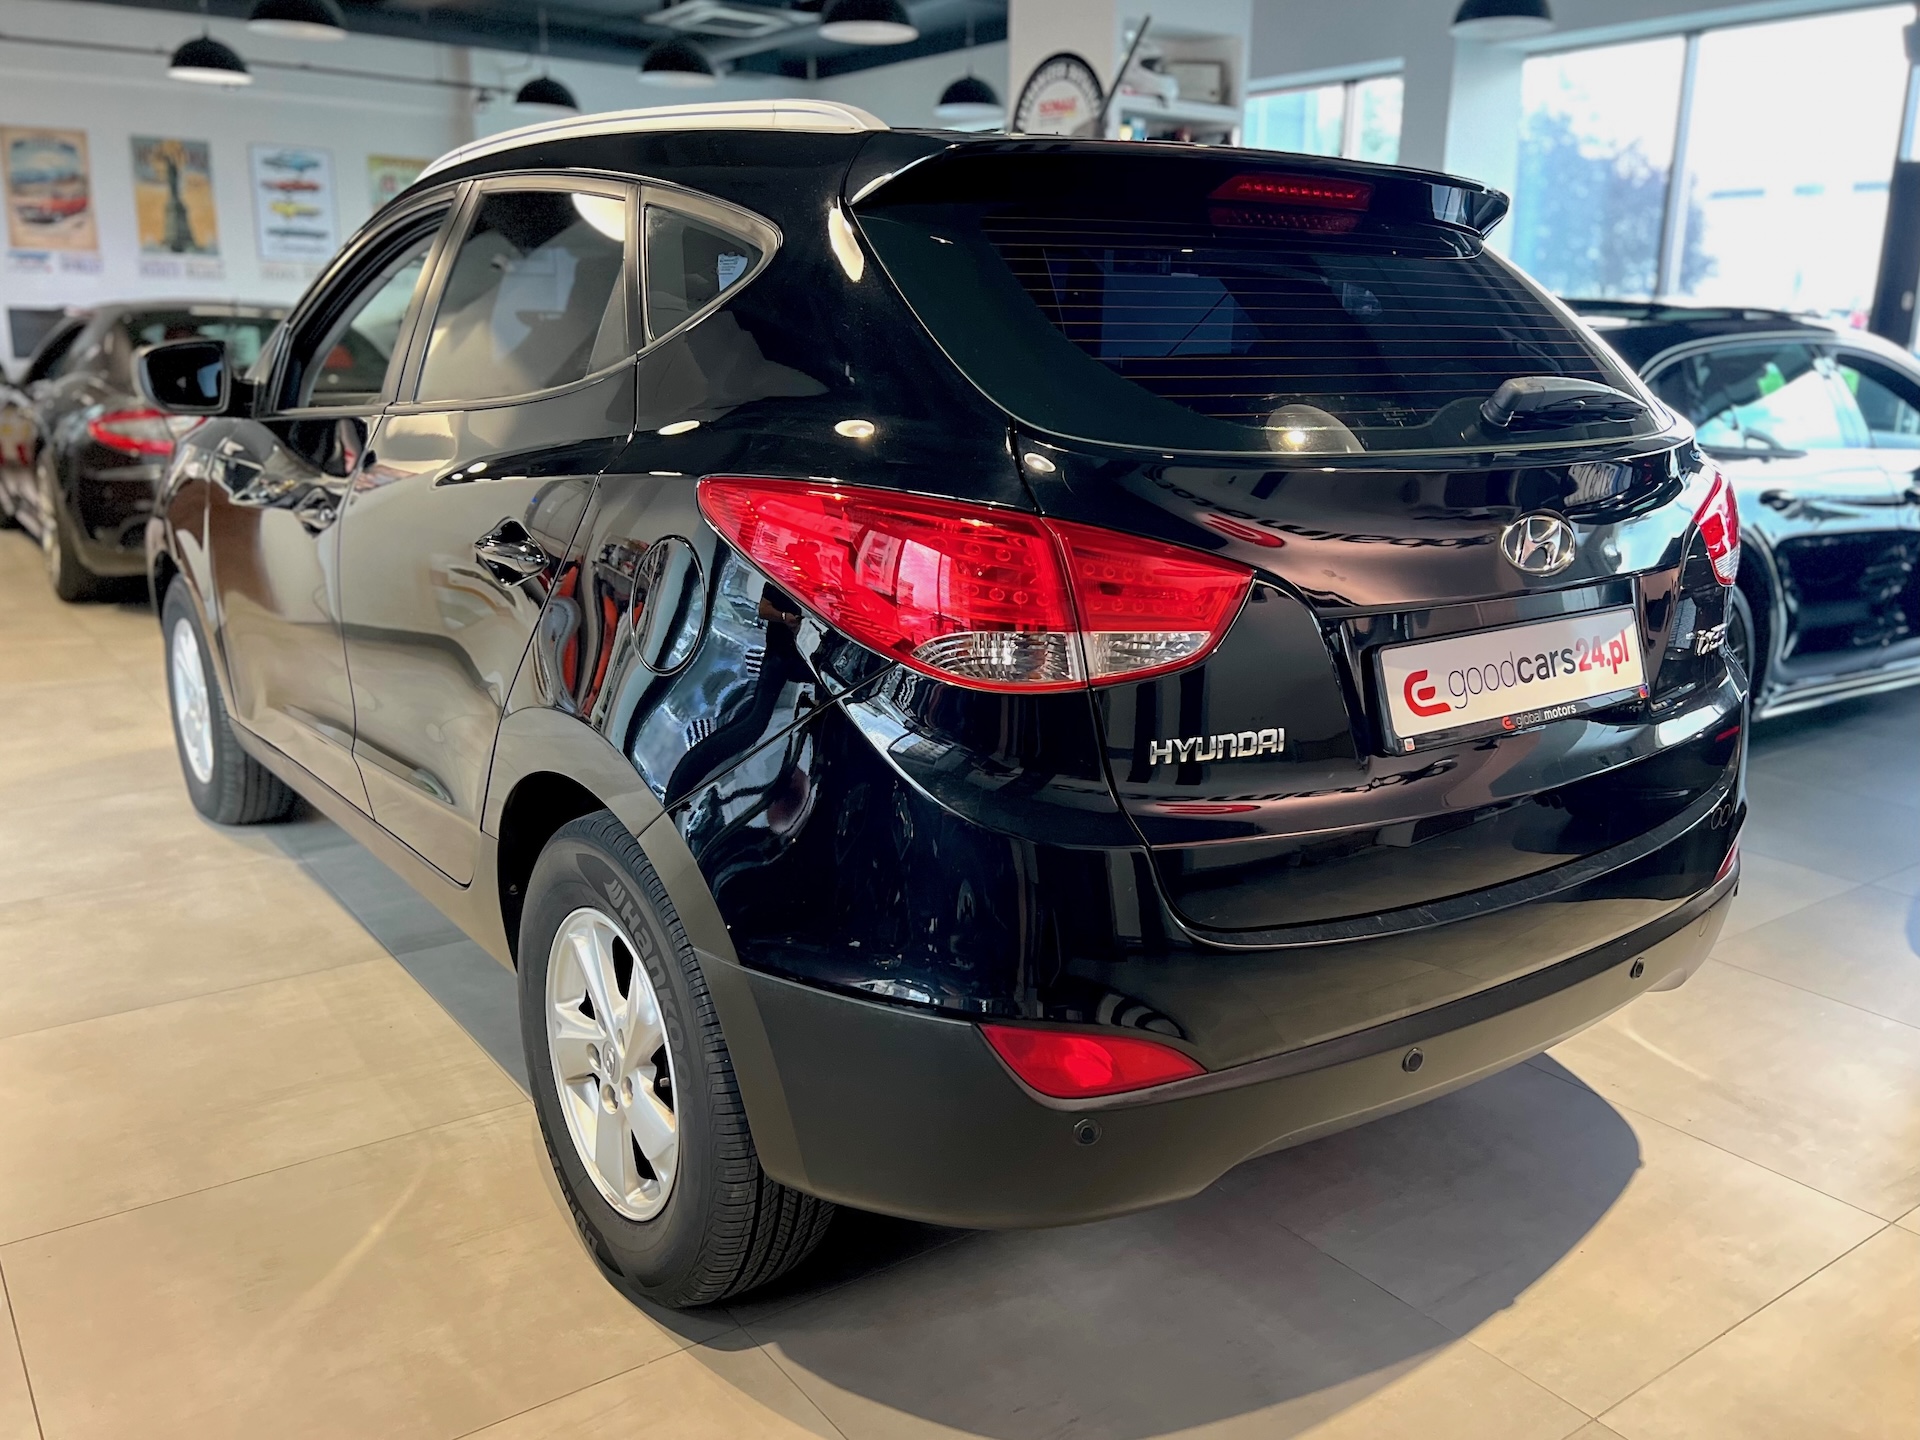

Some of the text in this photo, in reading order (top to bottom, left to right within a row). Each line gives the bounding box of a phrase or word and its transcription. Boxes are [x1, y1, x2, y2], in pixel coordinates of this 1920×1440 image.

[1448, 630, 1630, 709] goodcars24.pl
[1515, 704, 1577, 729] global motors
[1150, 727, 1285, 765] HYUNDAI
